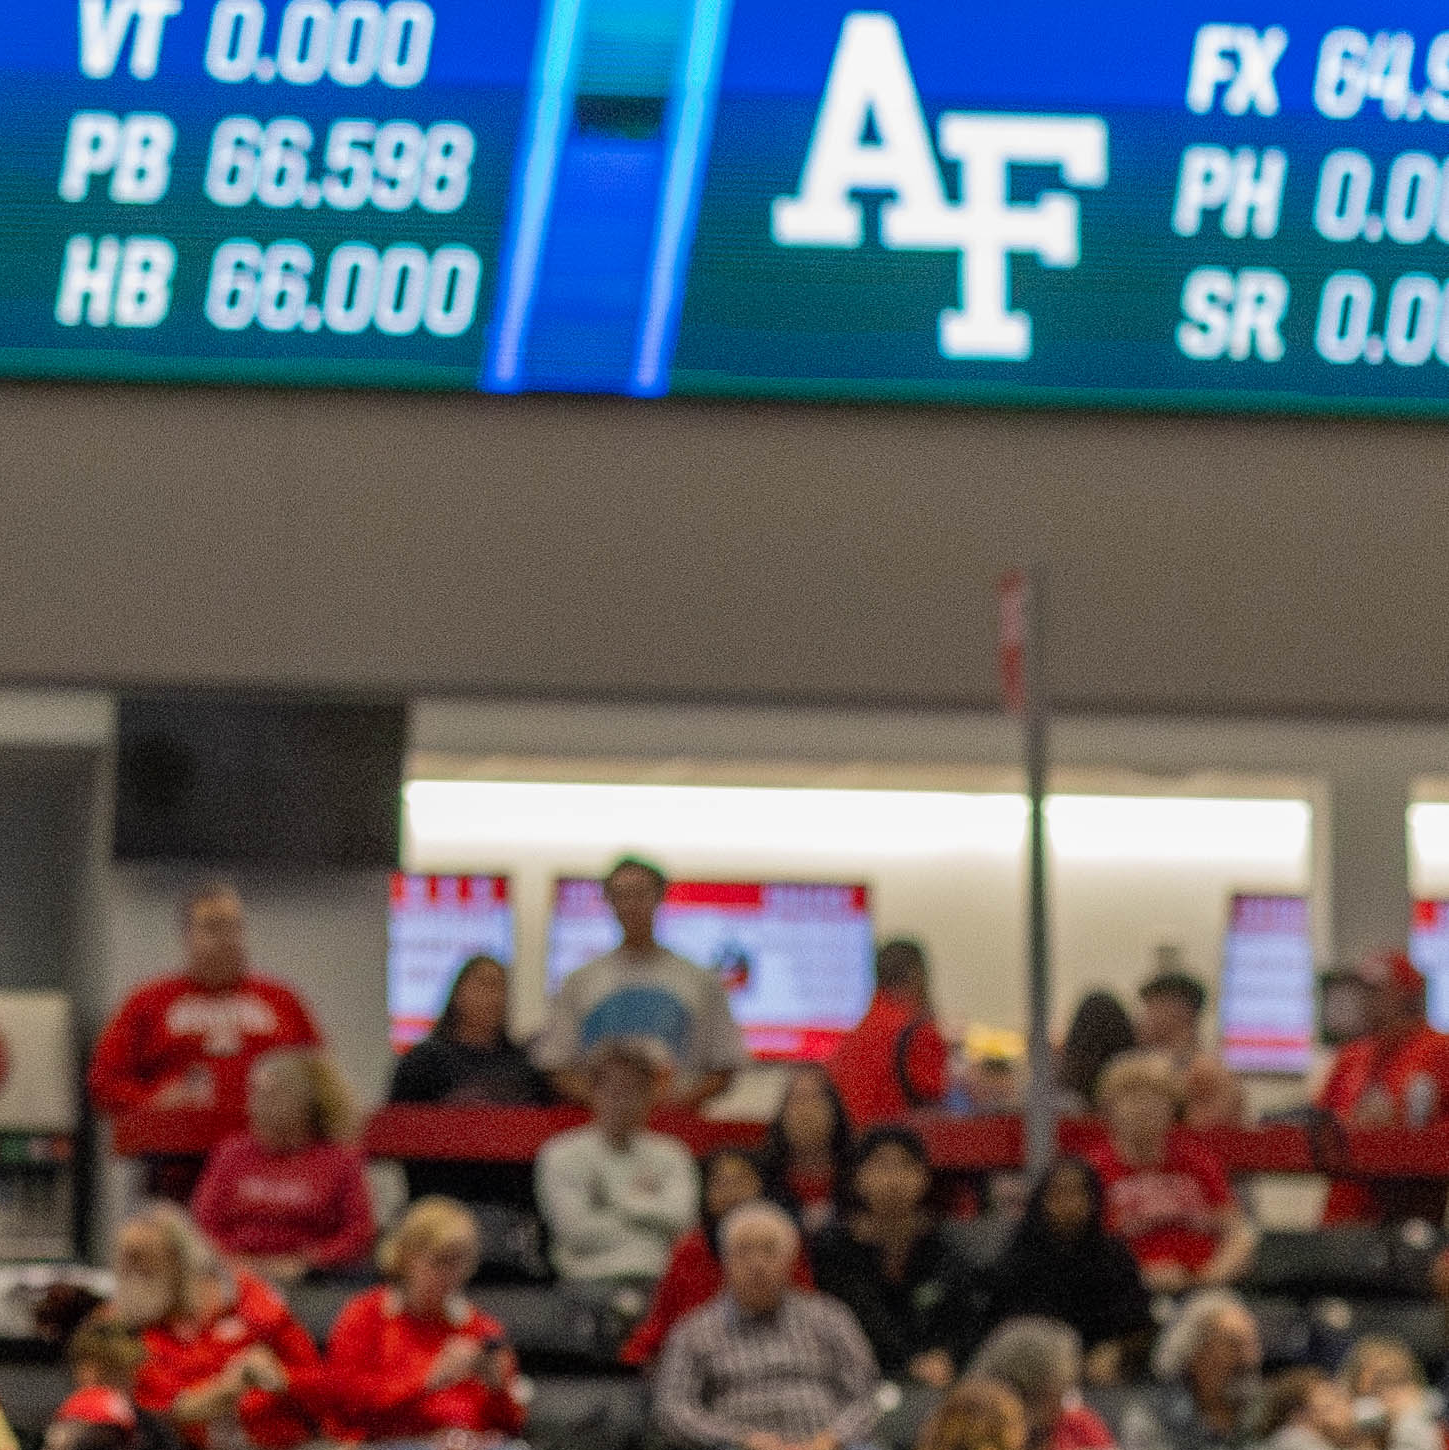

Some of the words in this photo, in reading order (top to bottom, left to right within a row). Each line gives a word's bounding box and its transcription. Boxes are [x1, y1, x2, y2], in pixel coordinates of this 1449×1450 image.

[77, 0, 181, 80] VT
[204, 0, 435, 86] 0.000
[1185, 22, 1288, 118] FX
[58, 111, 177, 204] PB
[204, 116, 475, 212] 66.598
[769, 10, 1109, 361] AF
[1171, 143, 1288, 239] PH
[1313, 148, 1449, 244] 0.0
[54, 234, 177, 327] HB
[204, 238, 483, 336] 66.000
[1175, 265, 1289, 363] SR
[1314, 269, 1449, 366] 0.0
